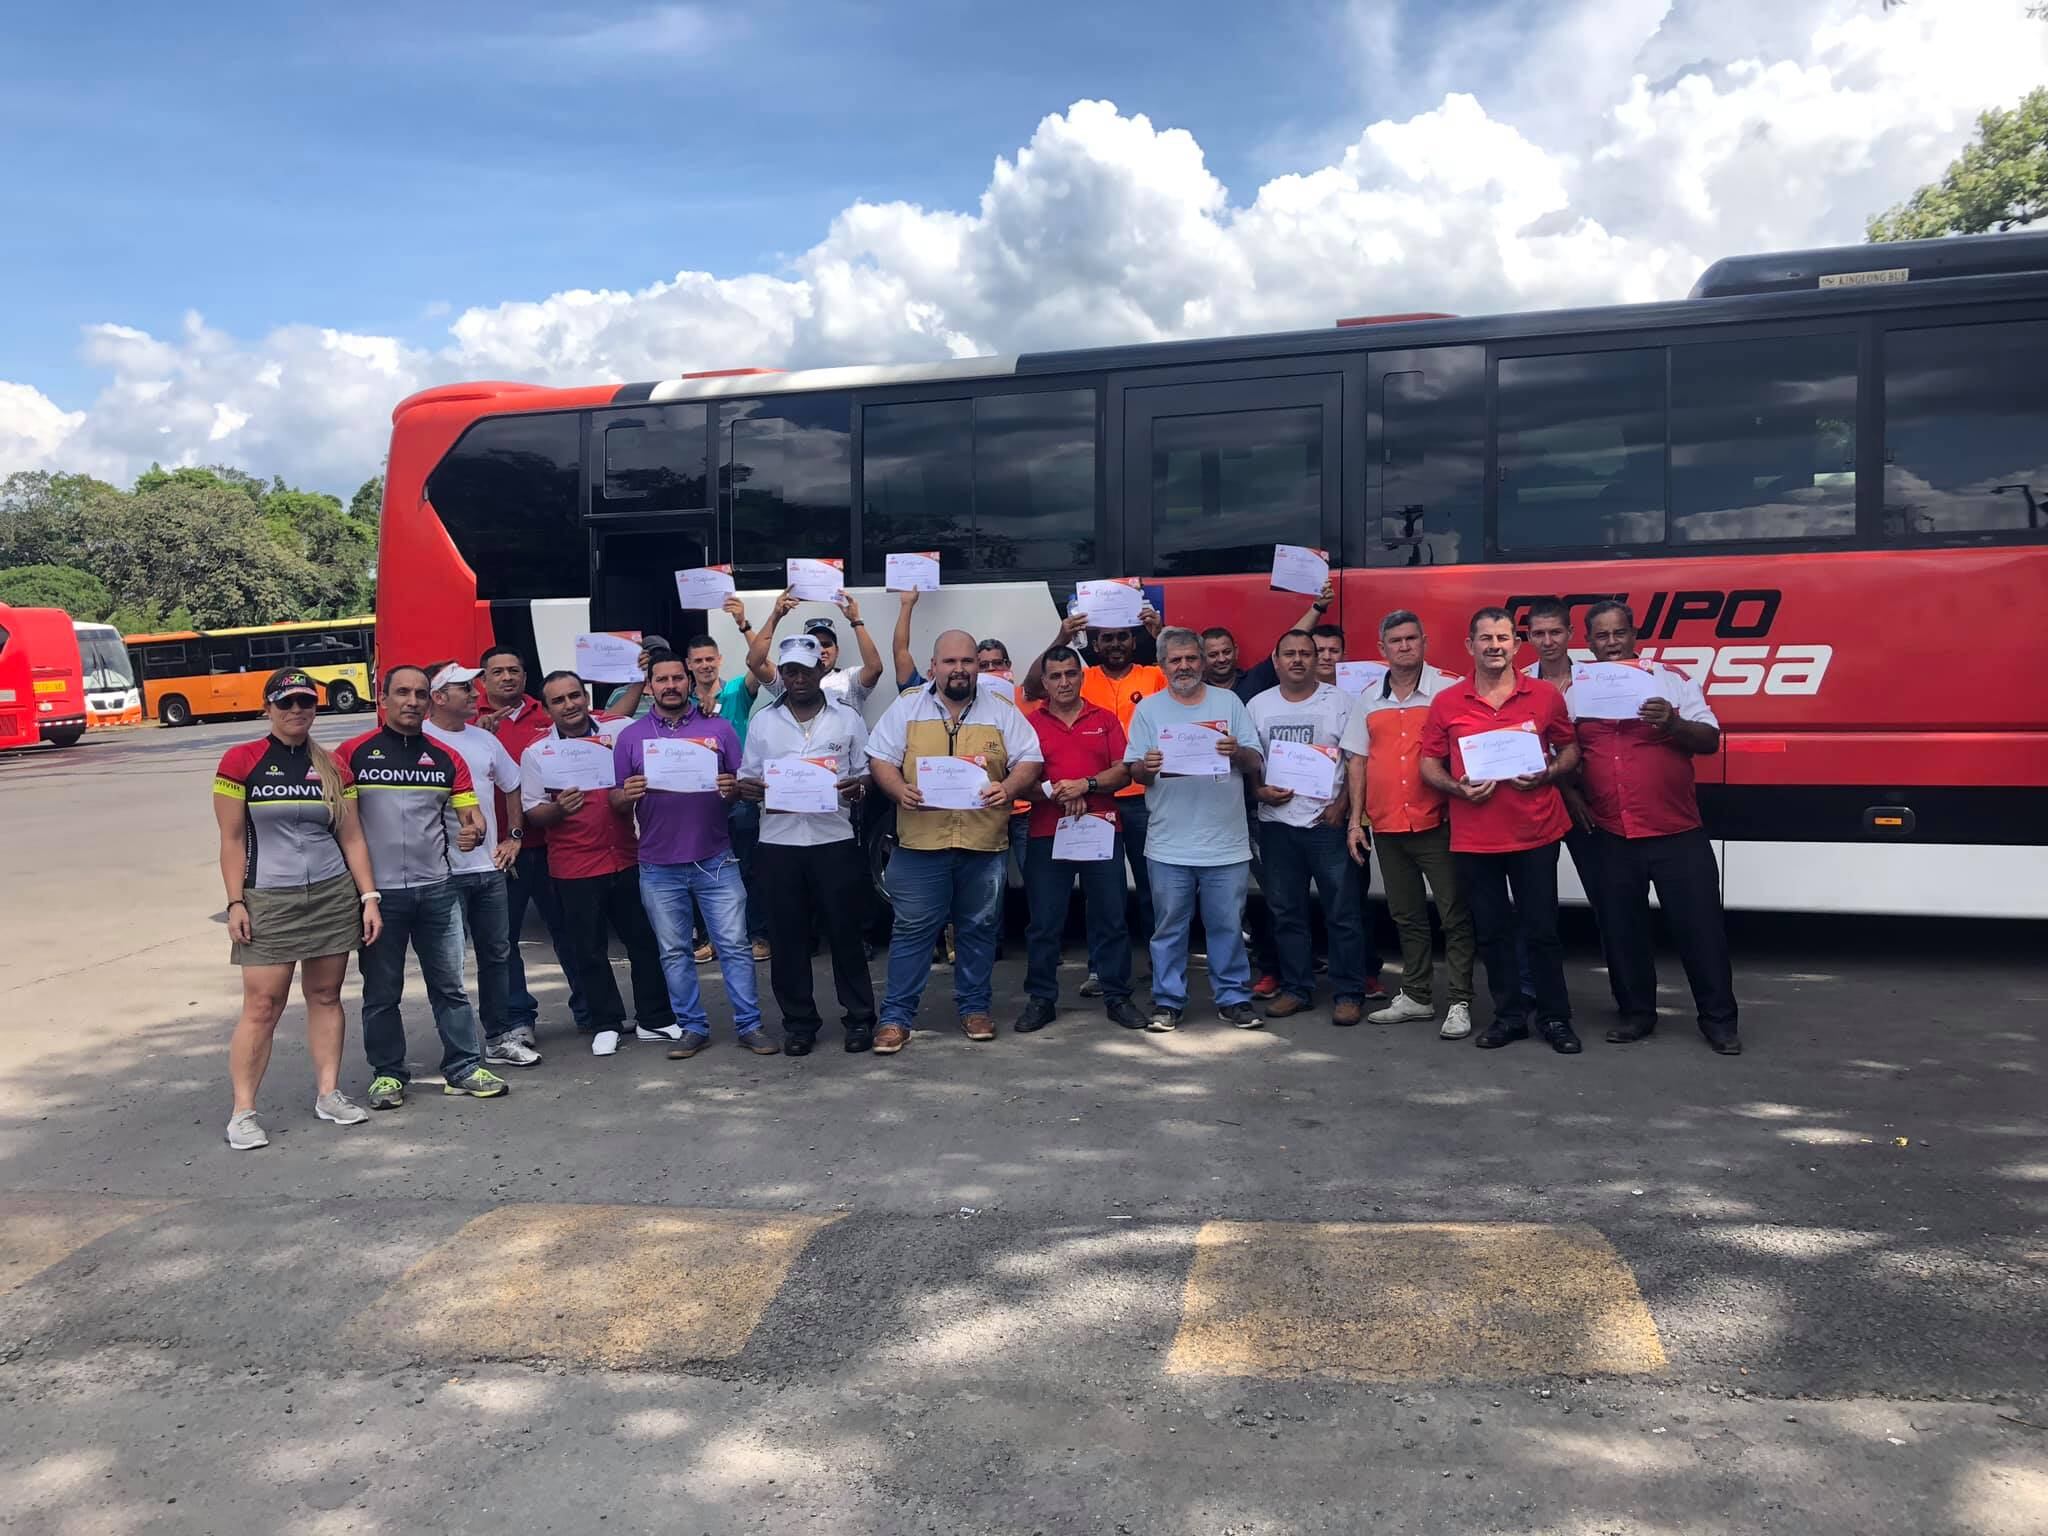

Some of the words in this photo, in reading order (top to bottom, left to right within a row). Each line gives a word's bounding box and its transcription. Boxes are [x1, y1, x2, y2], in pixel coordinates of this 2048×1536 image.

[1272, 728, 1312, 745] YONG
[358, 769, 446, 783] ACONVIVIR
[251, 784, 324, 797] ACONVIV
